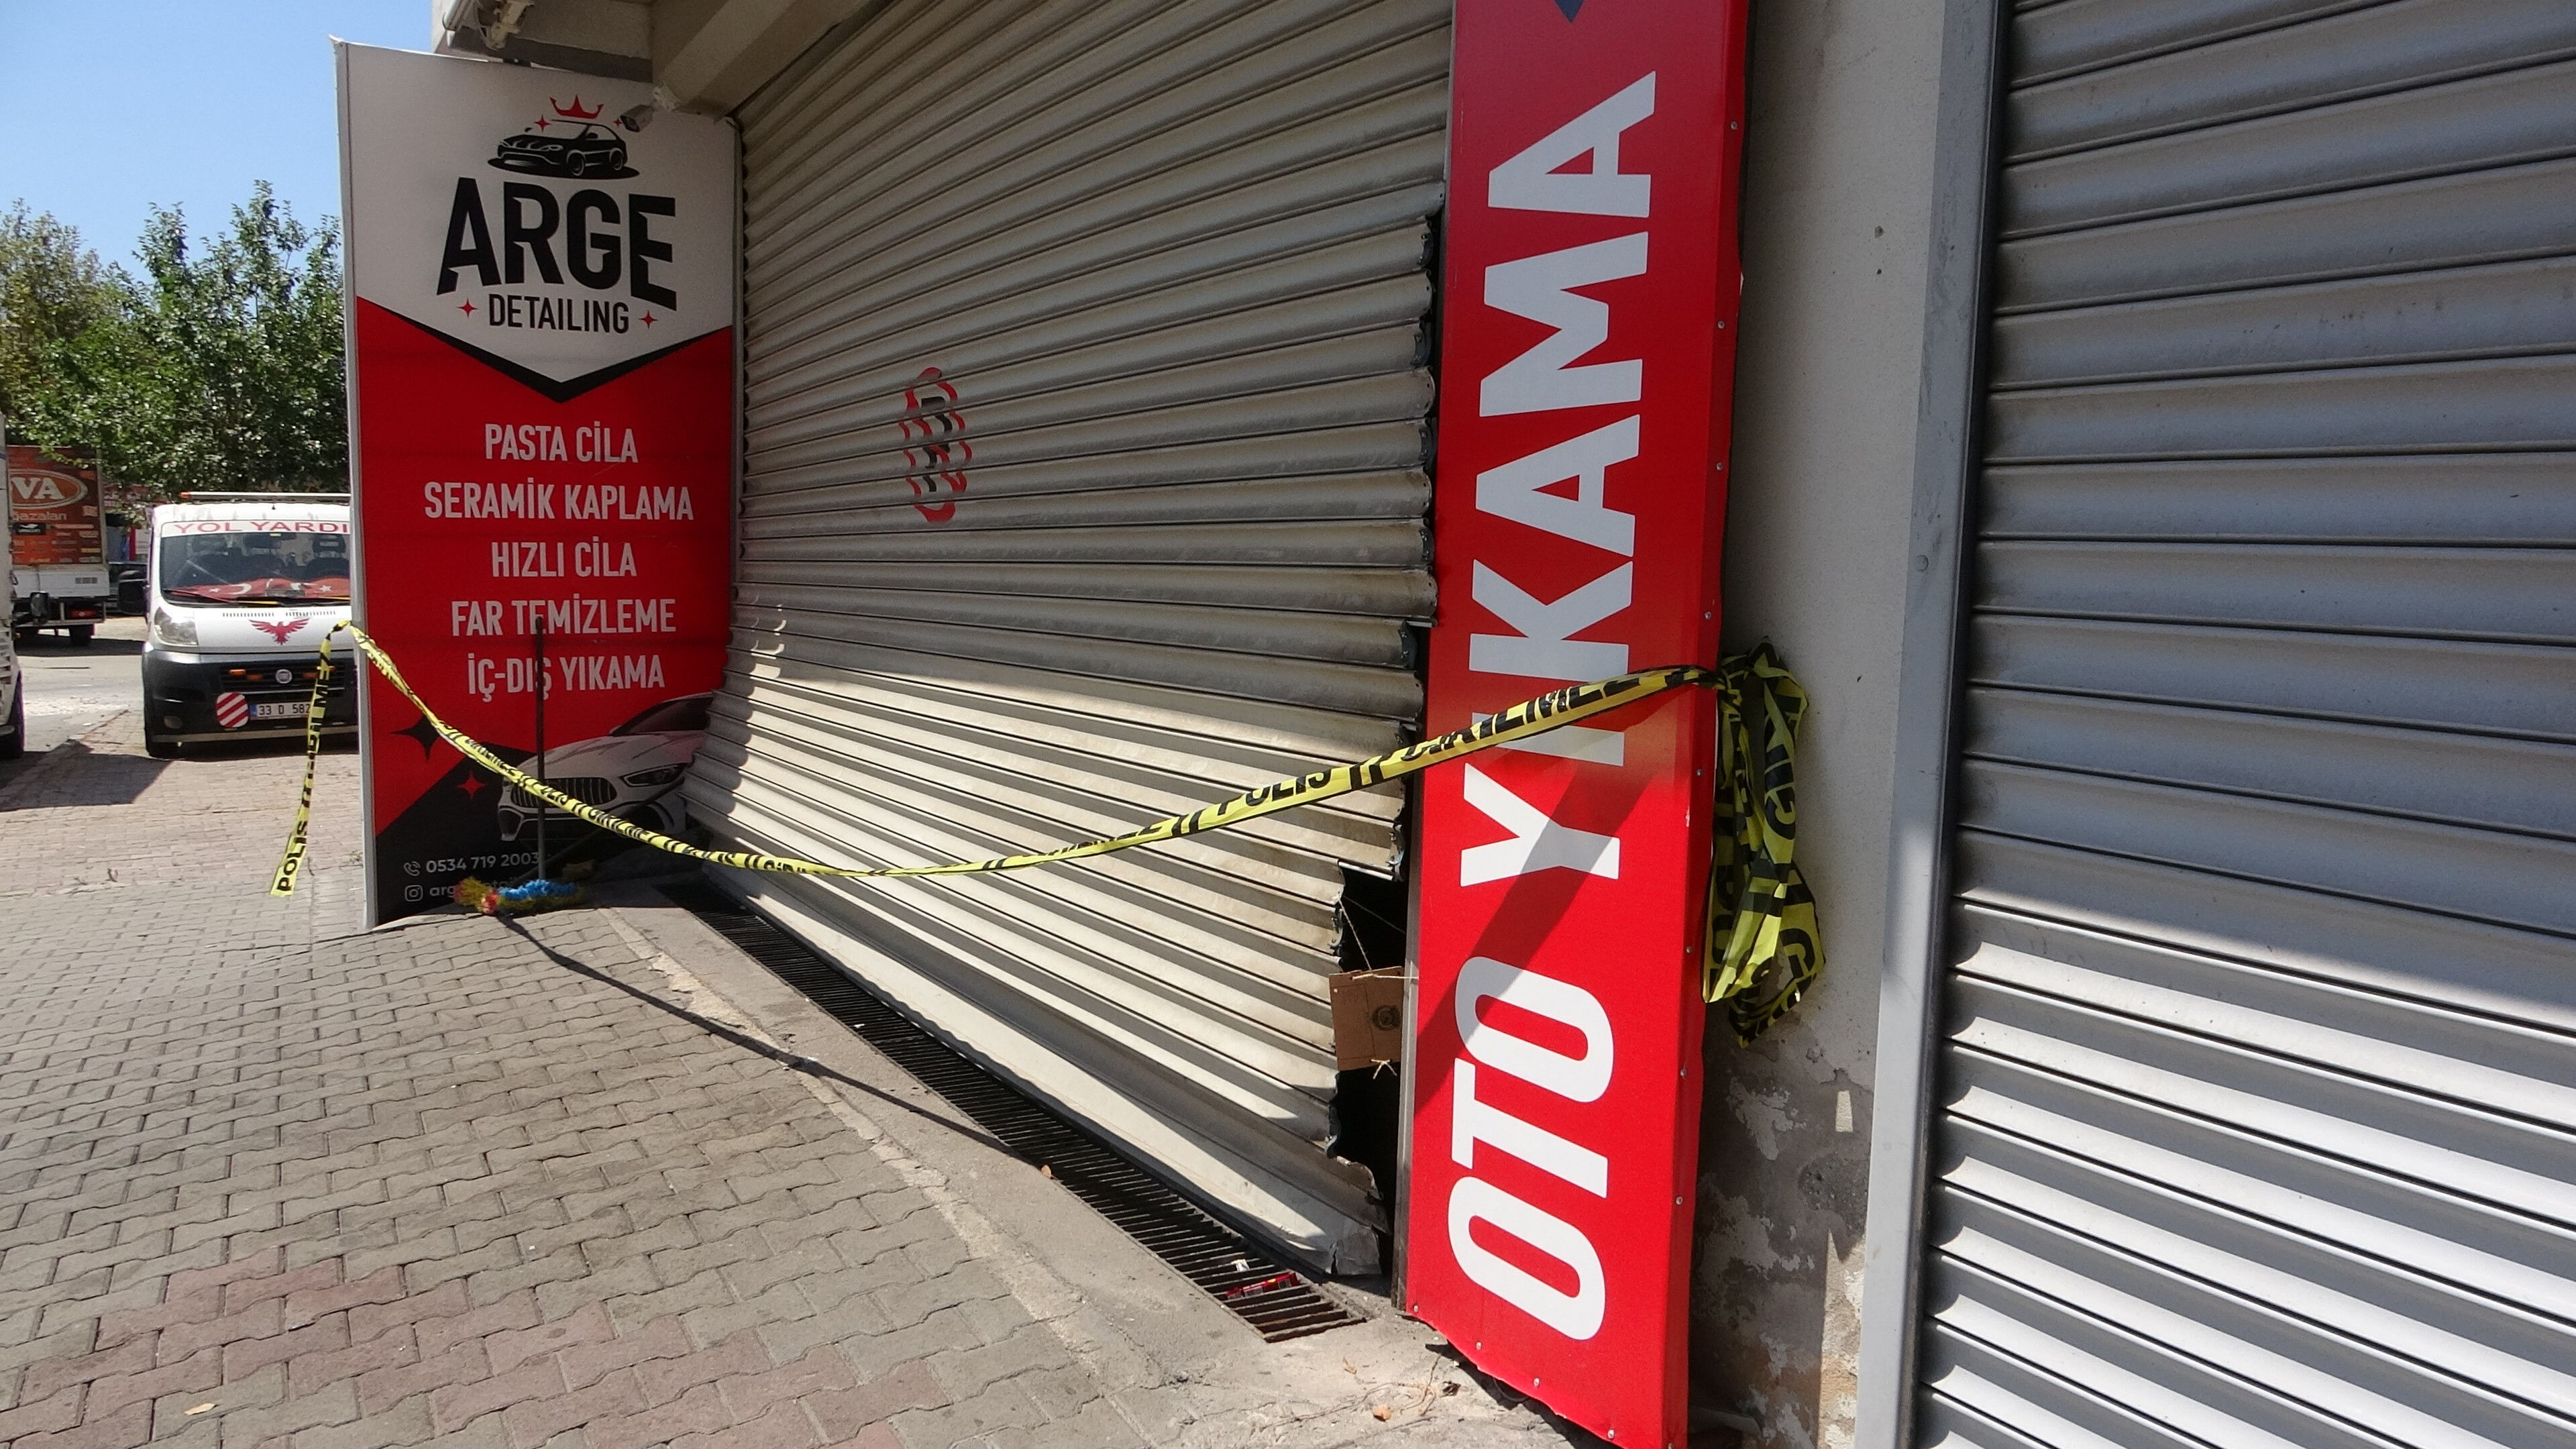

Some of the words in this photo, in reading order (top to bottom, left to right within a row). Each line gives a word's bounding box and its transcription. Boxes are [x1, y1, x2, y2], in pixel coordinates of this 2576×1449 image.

[436, 176, 677, 311] ARGE
[488, 293, 629, 334] DETAILING
[485, 423, 568, 462] PASTA
[576, 421, 639, 463] CİLA
[11, 476, 65, 500] VA
[424, 477, 555, 519] SERAMİK
[565, 484, 694, 520] KAPLAMA
[174, 522, 242, 533] YOL
[250, 521, 348, 532] YARDI
[492, 542, 564, 577] HIZLI
[575, 536, 637, 577] CİLA
[451, 600, 503, 637] FAR
[511, 593, 676, 635] TEMİZLEME
[468, 653, 552, 702] İÇ-DIŞ
[559, 655, 665, 691] YIKAMA
[259, 705, 272, 716] 33
[292, 703, 311, 714] 582
[426, 858, 467, 873] 0534
[471, 855, 496, 869] 719
[500, 852, 539, 867] 2003
[1448, 956, 1614, 1340] OTO
